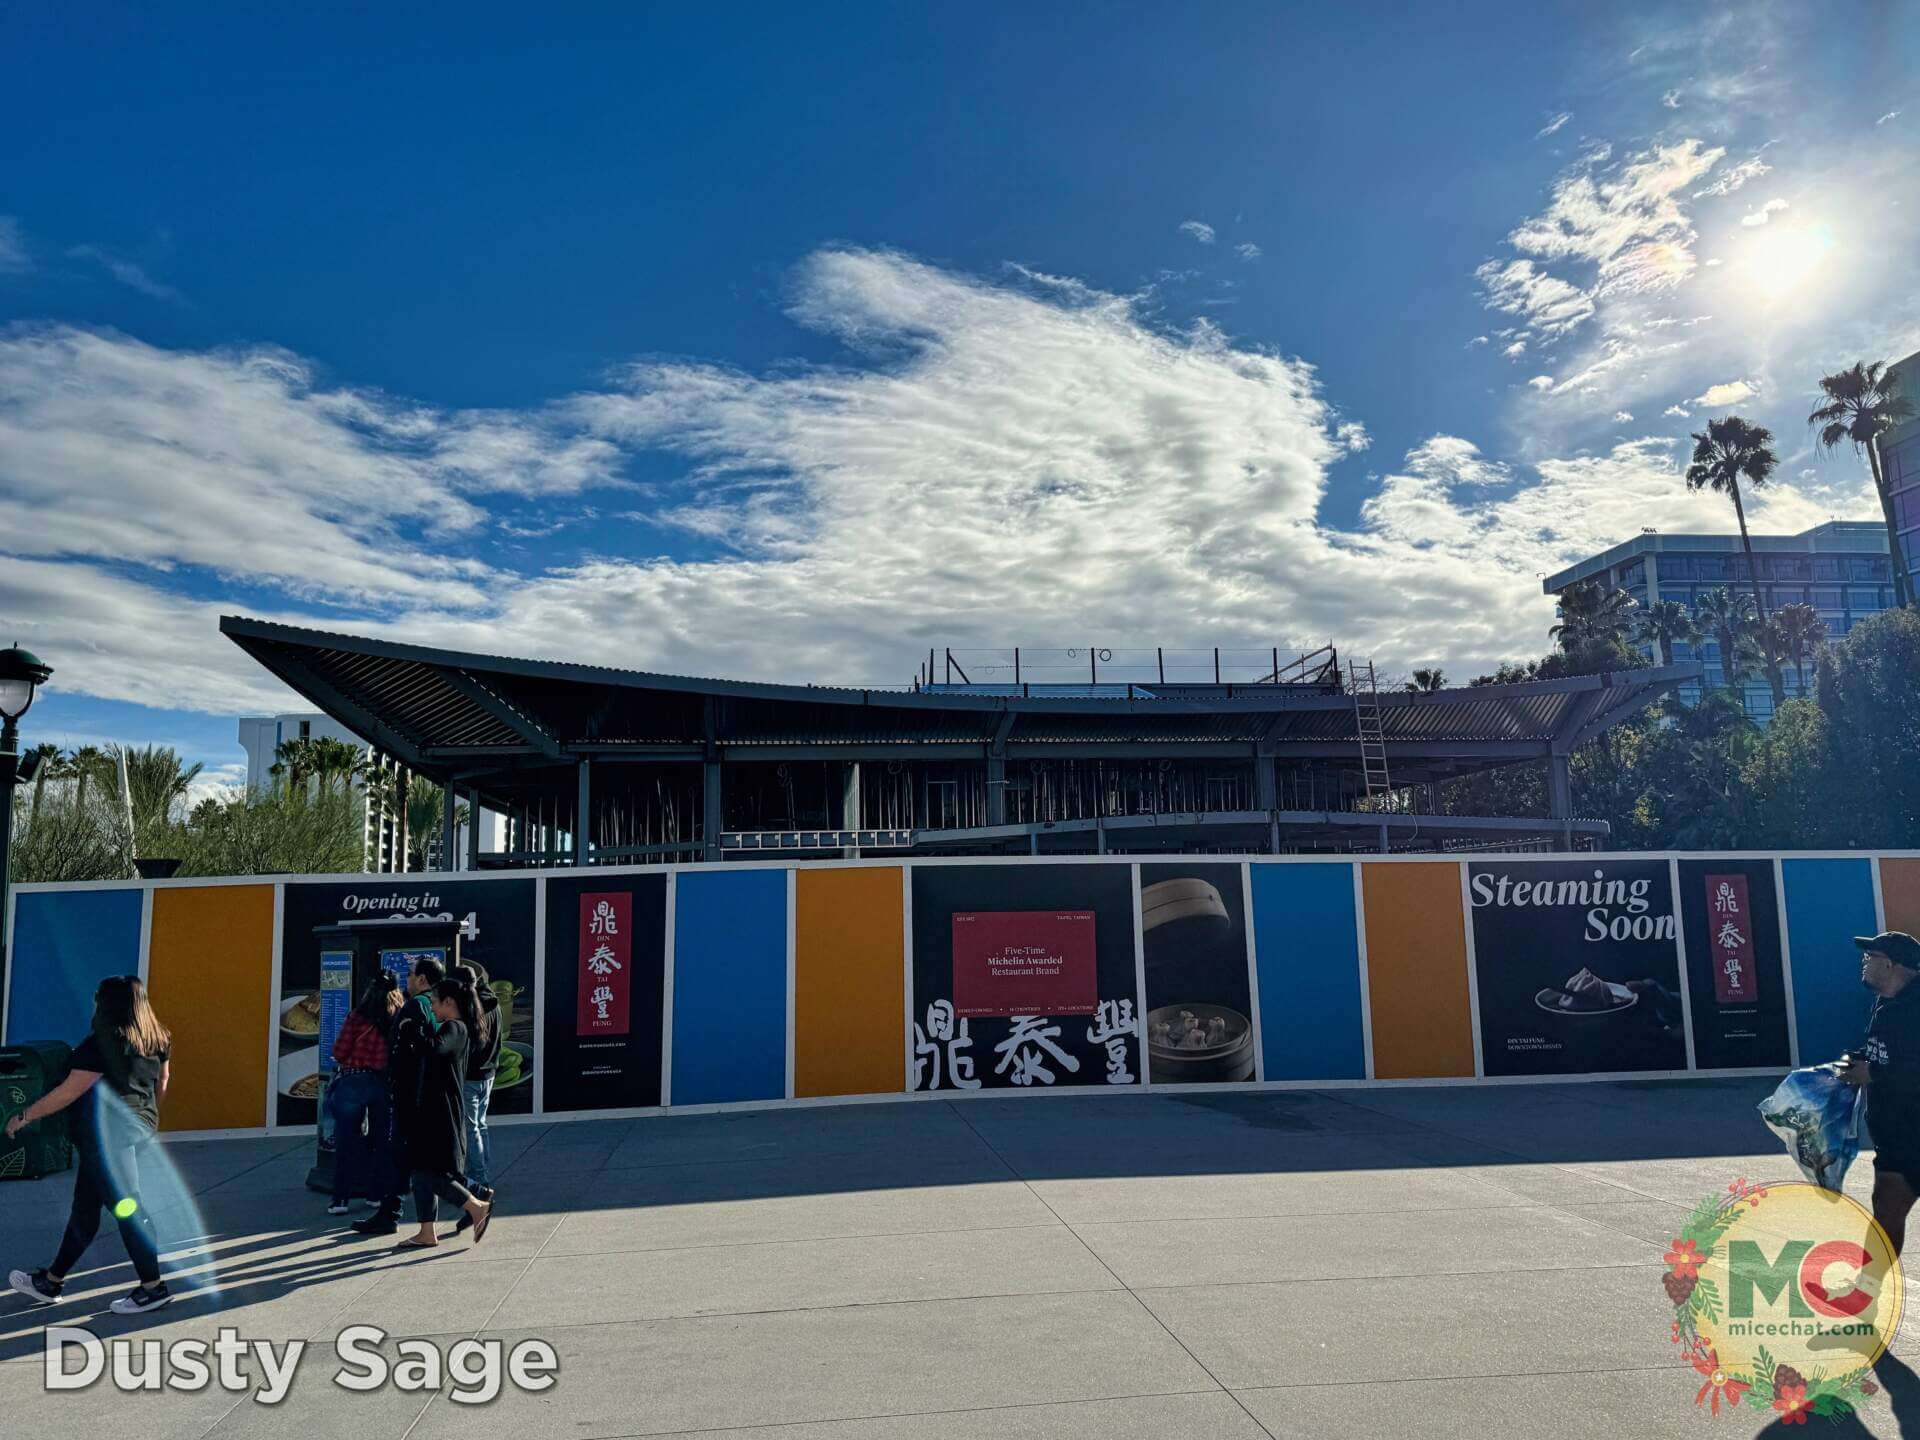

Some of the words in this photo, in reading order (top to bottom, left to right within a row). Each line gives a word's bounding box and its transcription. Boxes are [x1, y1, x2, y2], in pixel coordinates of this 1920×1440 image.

[342, 893, 420, 914] Opening
[422, 892, 440, 909] in
[1471, 869, 1651, 913] Steaming
[1584, 907, 1678, 942] Soon
[1717, 920, 1746, 949] 泰
[587, 944, 622, 975] 泰
[987, 957, 1024, 966] Michelin
[1025, 956, 1063, 965] Awarded
[1004, 946, 1046, 955] Five-Time
[991, 966, 1034, 976] Restaurant
[1035, 966, 1060, 975] Brand
